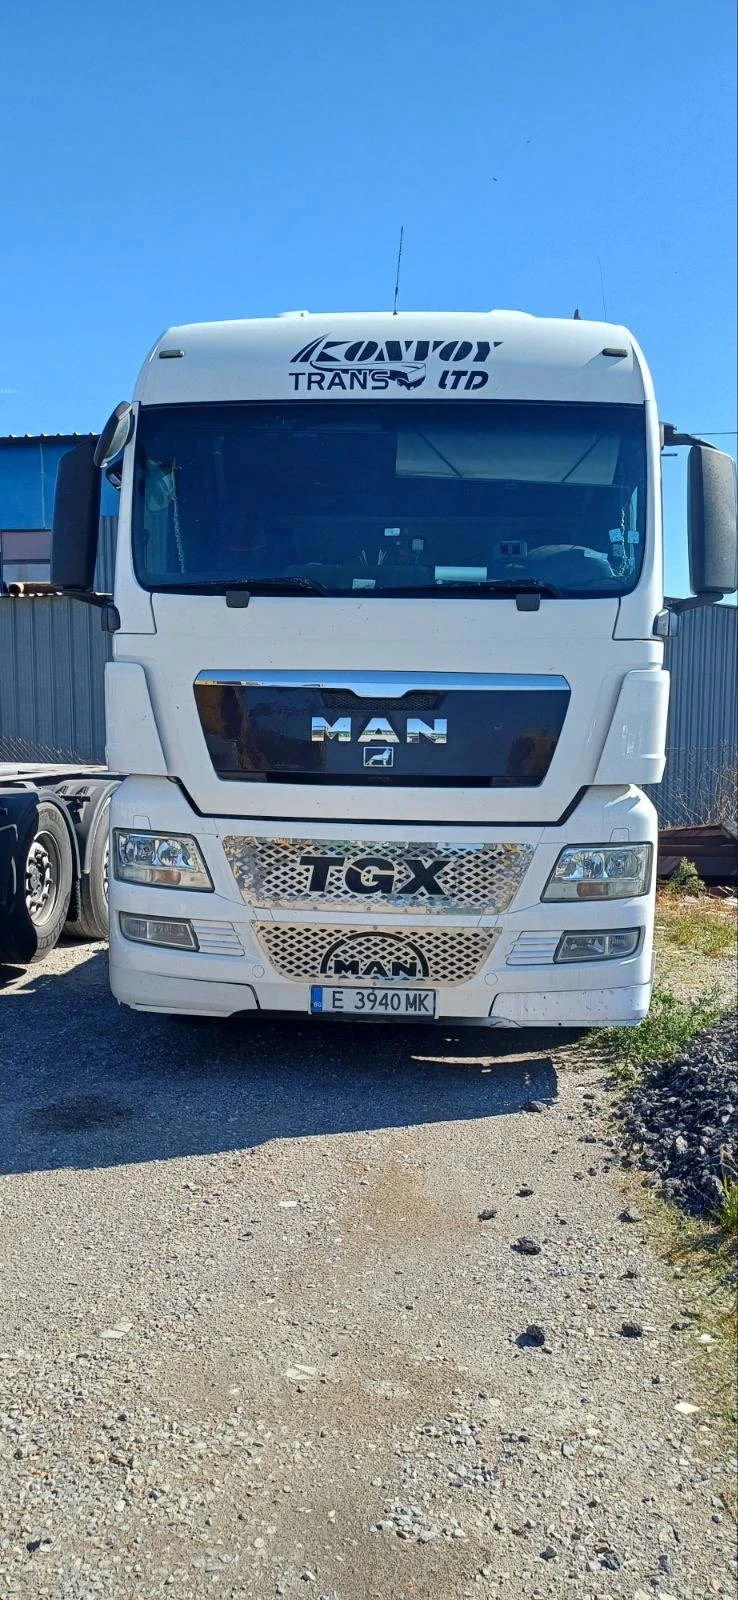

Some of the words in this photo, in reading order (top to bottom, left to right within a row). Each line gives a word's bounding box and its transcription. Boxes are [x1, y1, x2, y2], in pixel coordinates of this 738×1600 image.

[289, 371, 390, 391] TRANS
[438, 370, 489, 390] LTD
[311, 716, 448, 744] MAN
[300, 856, 450, 895] TGX
[333, 959, 417, 977] MAN
[332, 990, 344, 1009] E
[354, 991, 402, 1011] 3940
[405, 993, 430, 1012] MK
